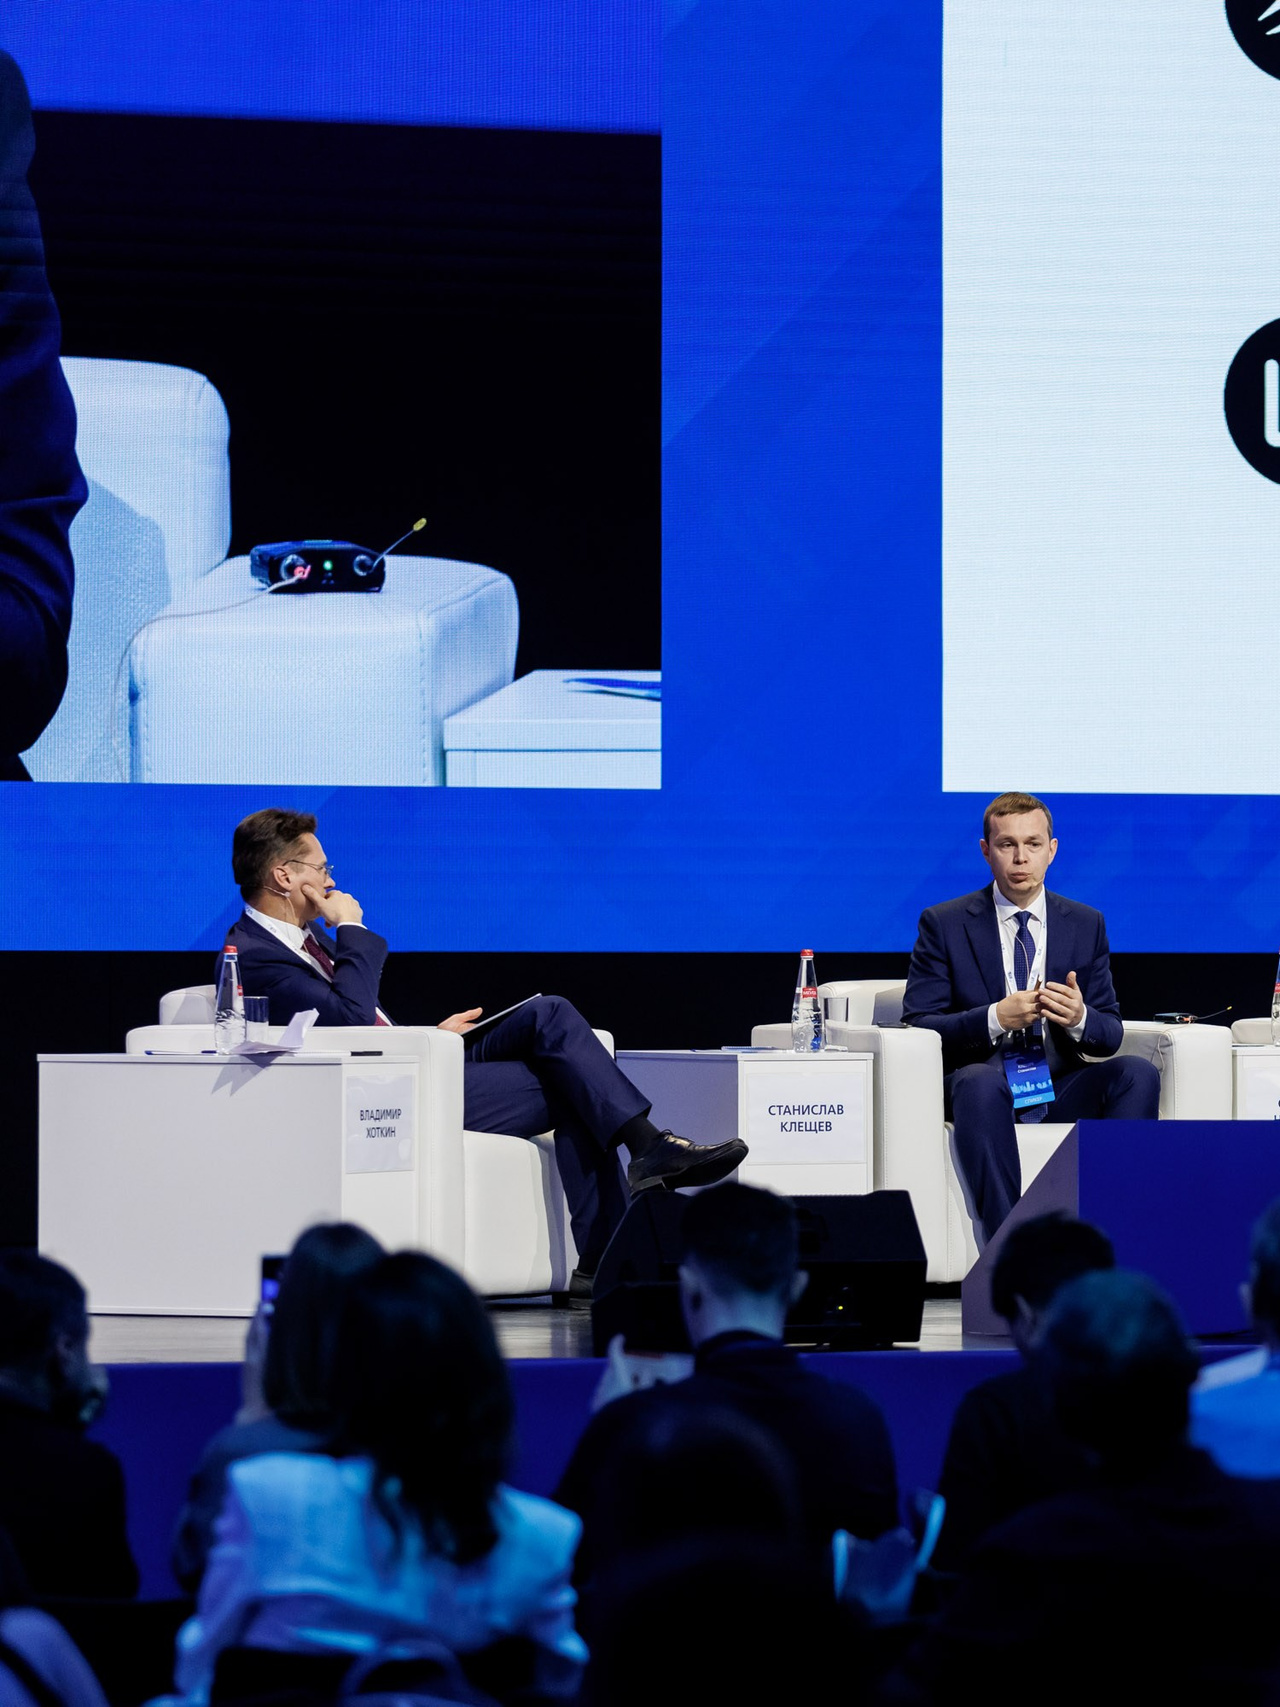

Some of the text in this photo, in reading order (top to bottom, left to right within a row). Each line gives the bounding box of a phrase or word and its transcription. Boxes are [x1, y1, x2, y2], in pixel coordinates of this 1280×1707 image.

[359, 1108, 403, 1122] ВЛАДИМИР
[767, 1103, 845, 1116] СТАНИСЛАВ
[365, 1126, 397, 1139] ХОТКИН
[780, 1120, 833, 1134] КЛЕЩЕВ
